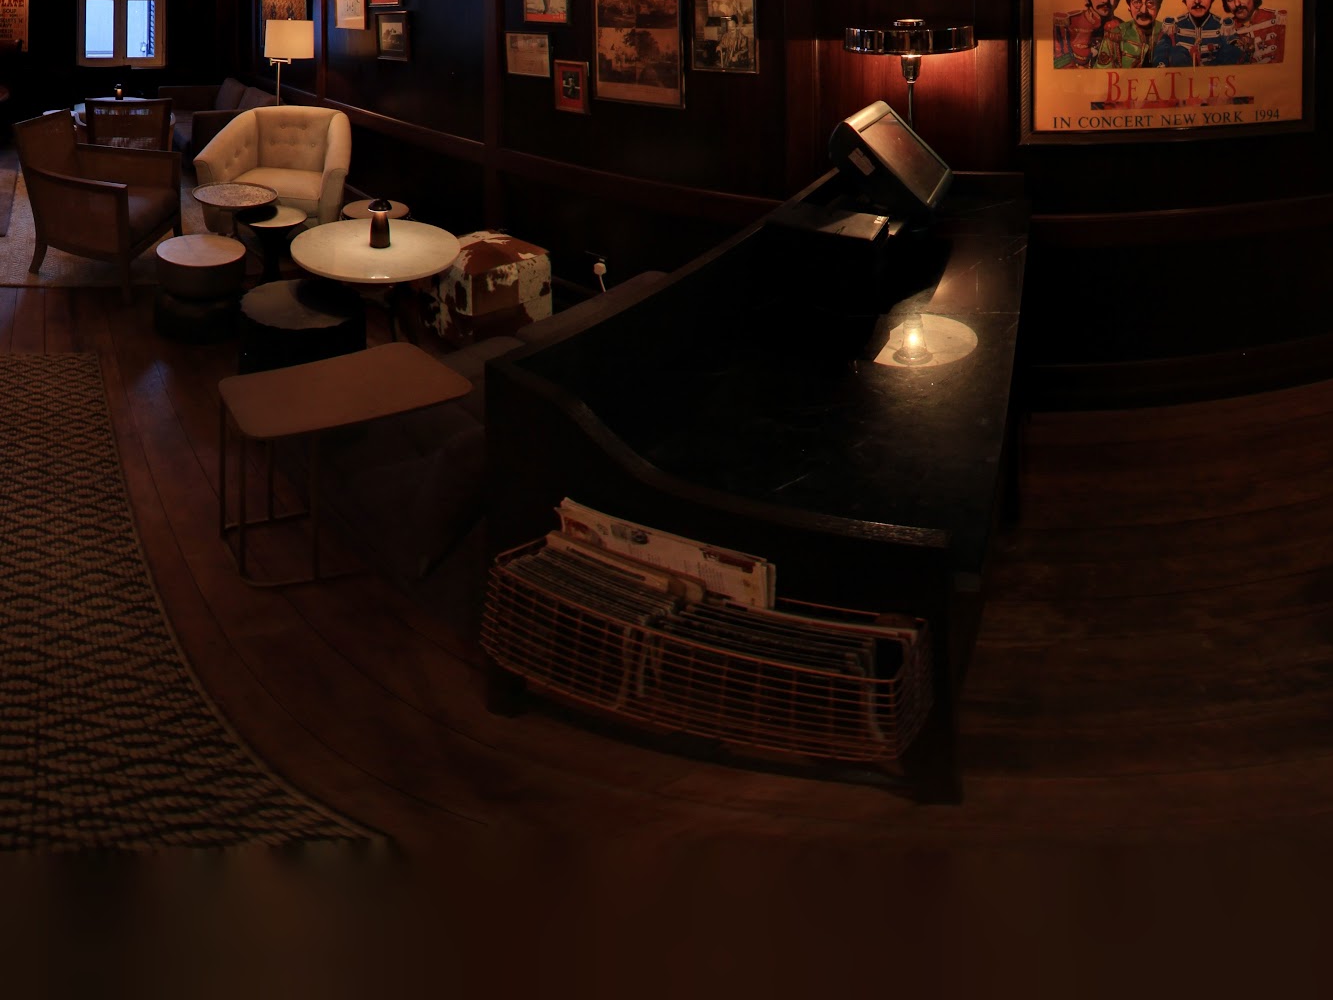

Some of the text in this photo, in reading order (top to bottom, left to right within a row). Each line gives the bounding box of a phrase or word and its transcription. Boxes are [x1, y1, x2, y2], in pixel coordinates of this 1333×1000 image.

[0, 0, 24, 8] LATE
[1105, 71, 1238, 102] BEATLES
[1052, 108, 1280, 129] IN CONCERT NEW YORK 1994
